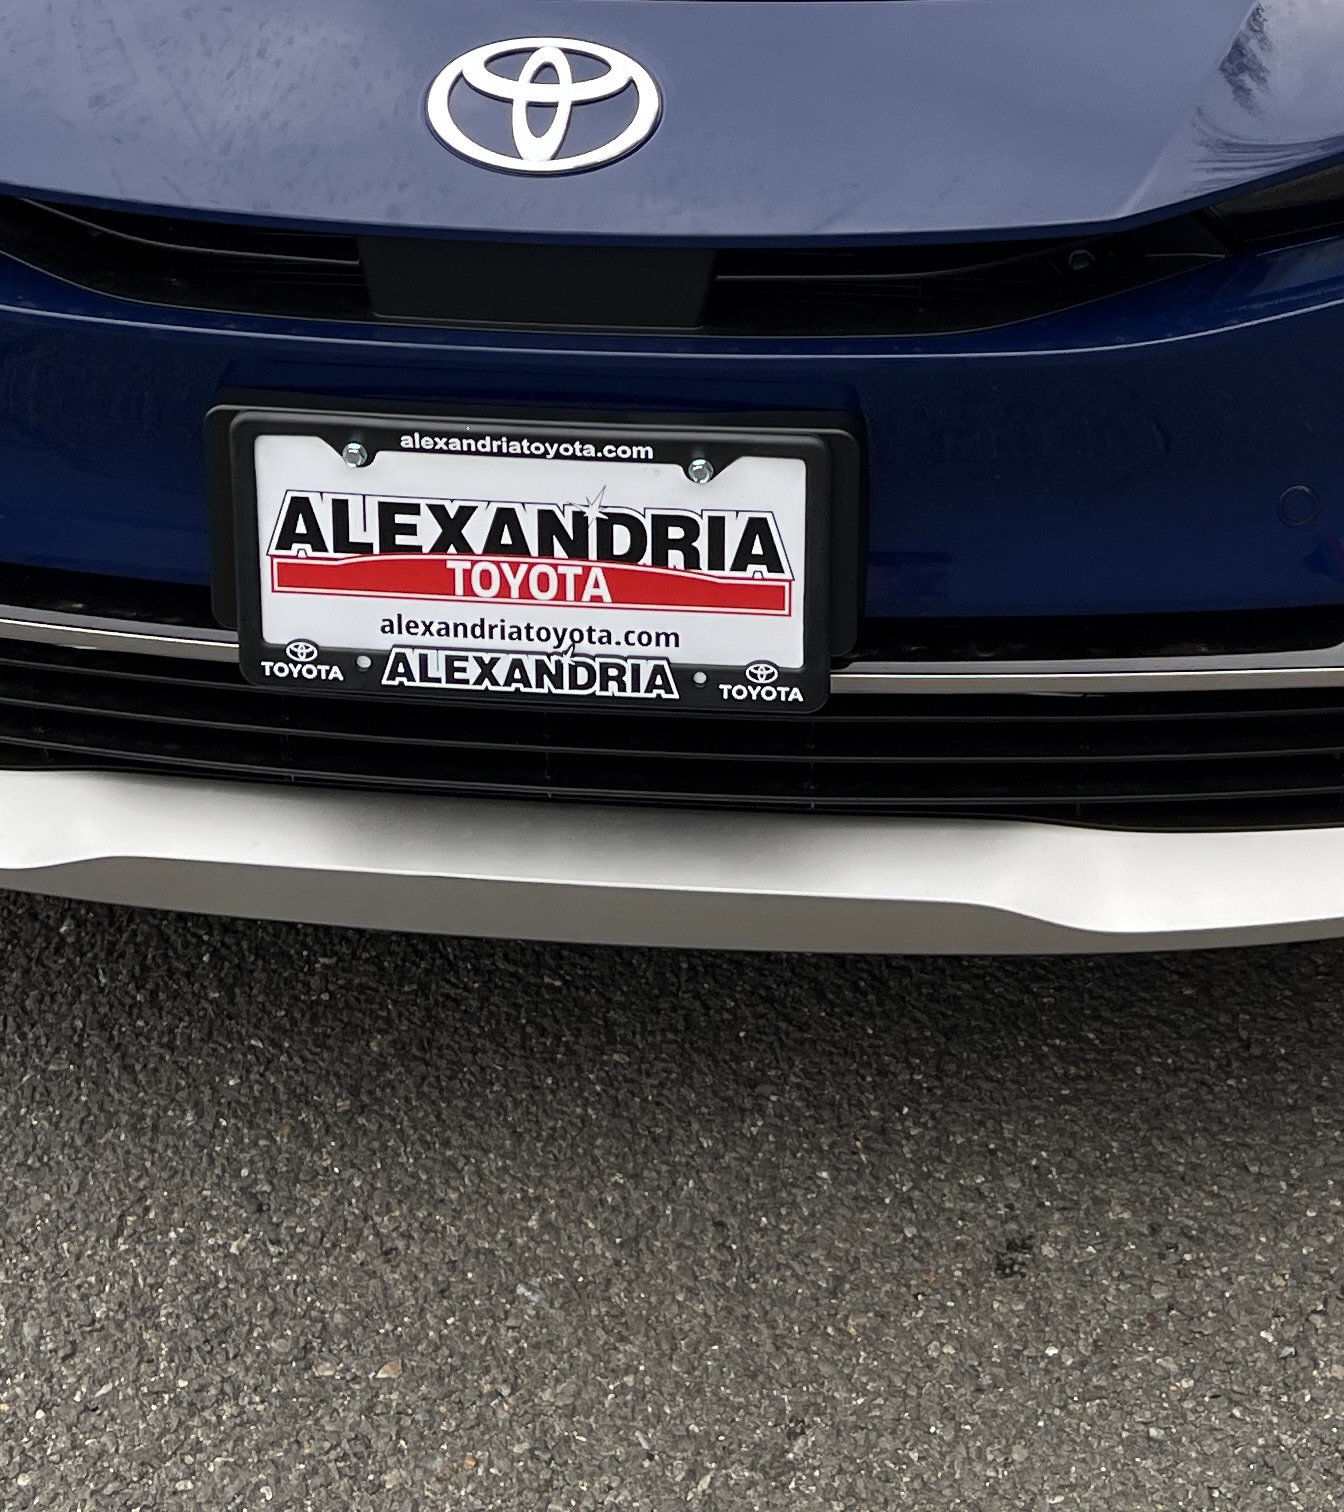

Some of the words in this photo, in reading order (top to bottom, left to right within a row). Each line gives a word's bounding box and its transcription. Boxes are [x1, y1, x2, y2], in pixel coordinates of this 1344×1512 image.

[399, 431, 654, 460] alexandriatoyota.com
[271, 492, 791, 578] ALEXANDRIA
[446, 559, 613, 604] TOYOTA
[379, 612, 681, 650] alexandriatoyota.com
[261, 660, 344, 683] TOYOTA
[381, 645, 680, 700] ALEXANDRIA
[718, 683, 804, 704] TOYOTA
